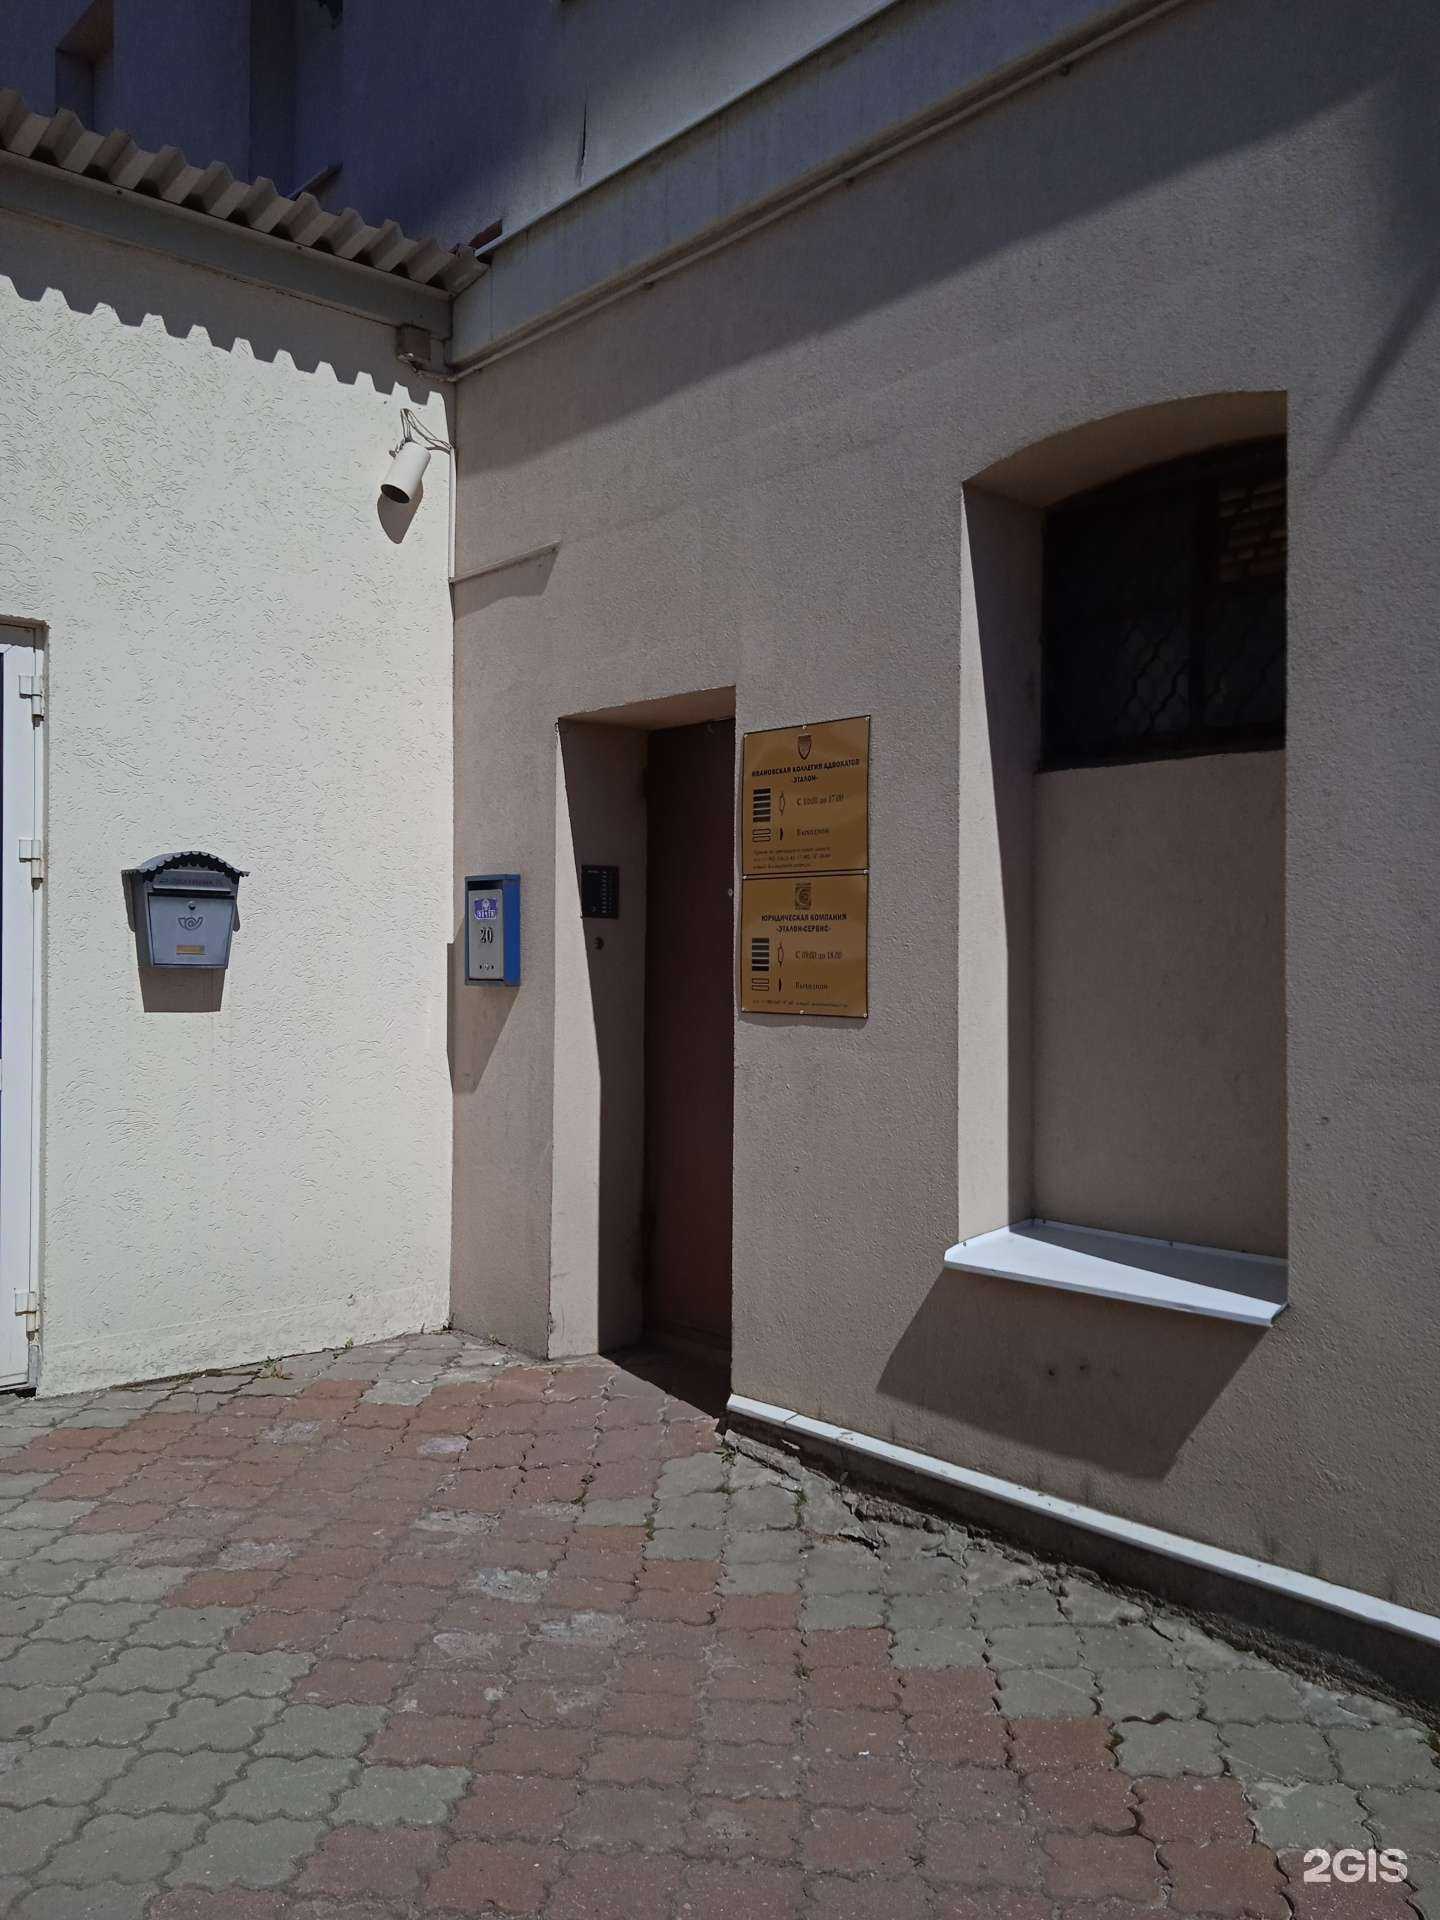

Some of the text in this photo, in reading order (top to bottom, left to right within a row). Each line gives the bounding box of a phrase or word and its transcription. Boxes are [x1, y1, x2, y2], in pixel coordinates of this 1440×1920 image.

[751, 758, 860, 777] ИВАНОВСКАЯ КОЛЛЕГИЯ АДВОКАТОВ
[761, 913, 848, 922] ЮРИДИЧЕСКАЯ КОМПАНИЯ
[479, 927, 494, 944] 20
